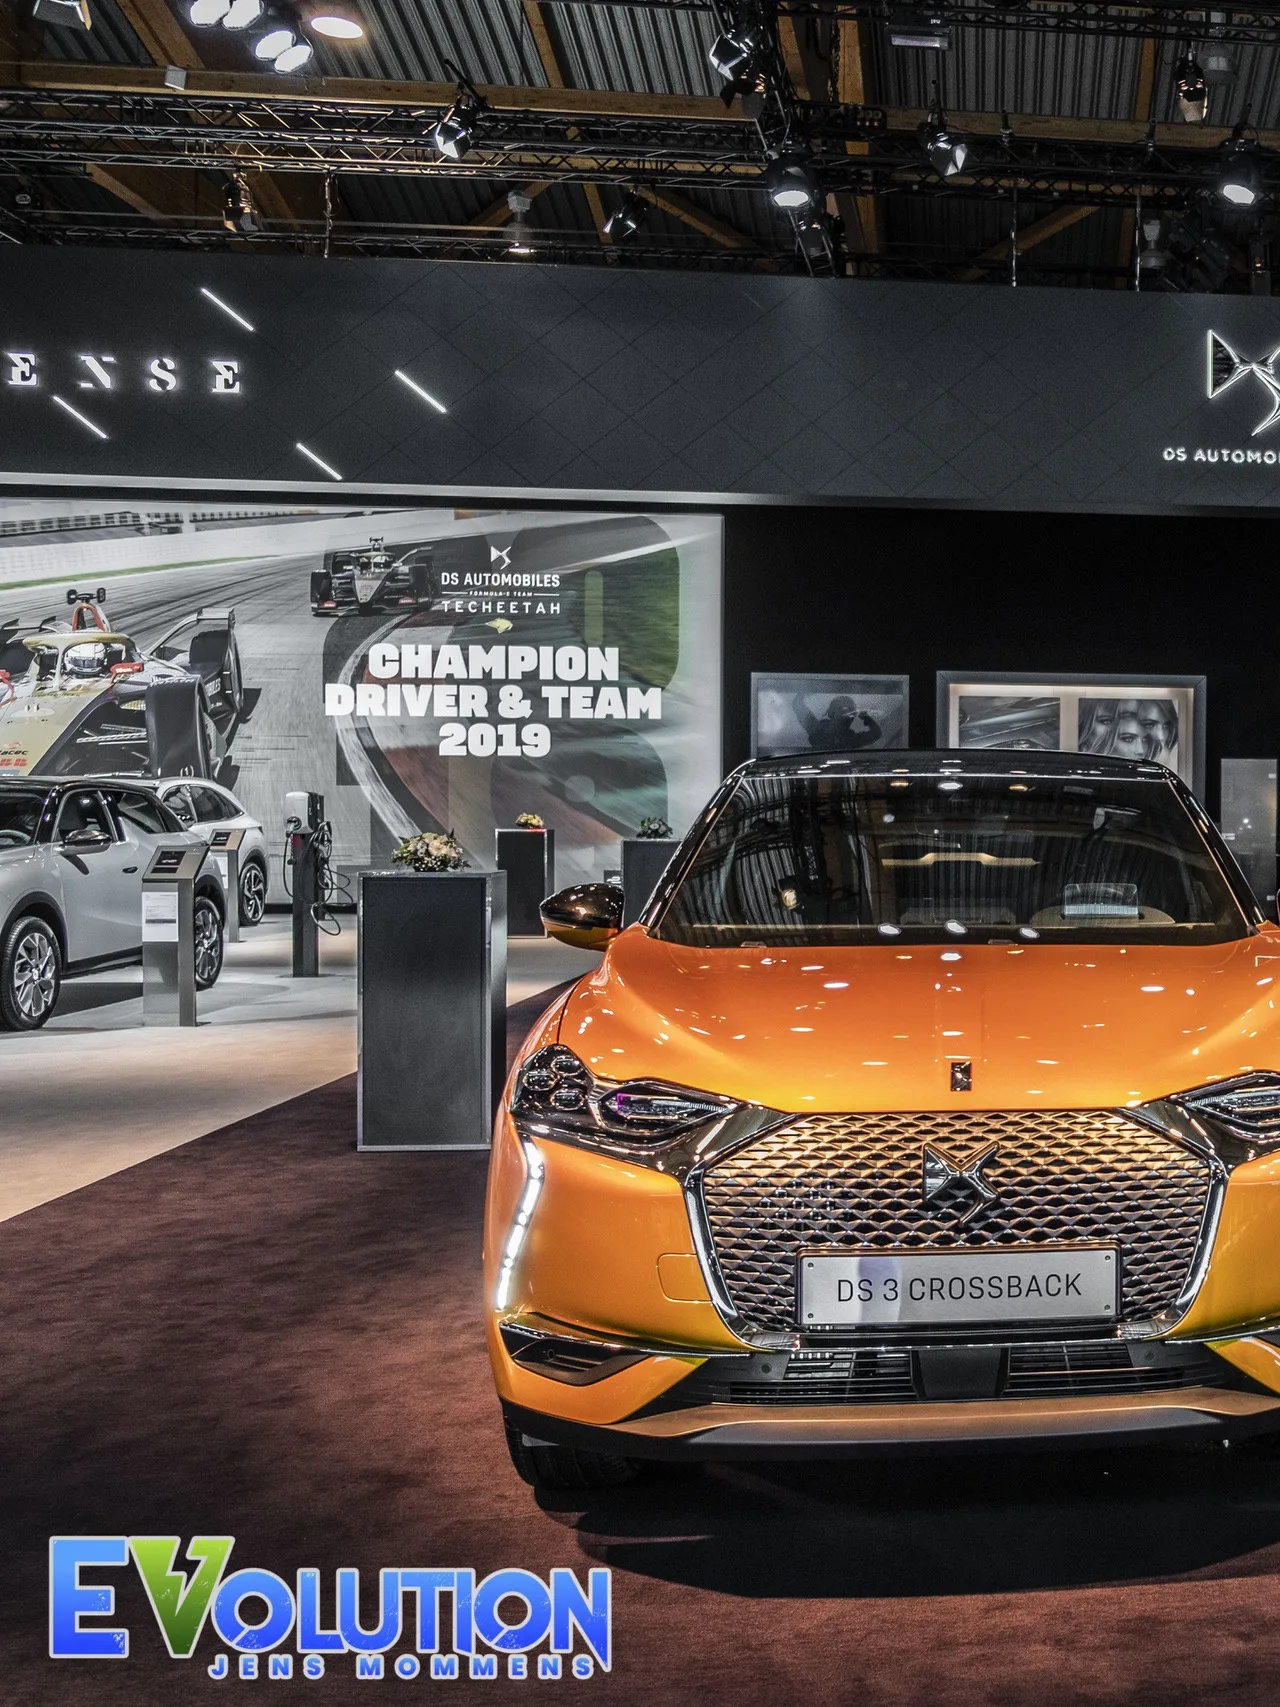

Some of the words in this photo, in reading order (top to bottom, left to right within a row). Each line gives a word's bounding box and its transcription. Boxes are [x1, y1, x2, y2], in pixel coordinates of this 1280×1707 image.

[1163, 447, 1187, 462] DS
[441, 572, 459, 586] DS
[464, 573, 560, 588] AUTOMOBILES
[441, 601, 560, 614] TECHEETAH
[368, 643, 620, 681] CHAMPION
[324, 683, 489, 718] DRIVER
[498, 685, 533, 719] &
[541, 686, 662, 719] TEAM
[438, 722, 551, 757] 2019
[837, 1278, 873, 1302] DS
[882, 1278, 898, 1301] 3
[908, 1272, 1083, 1301] CROSSBACK
